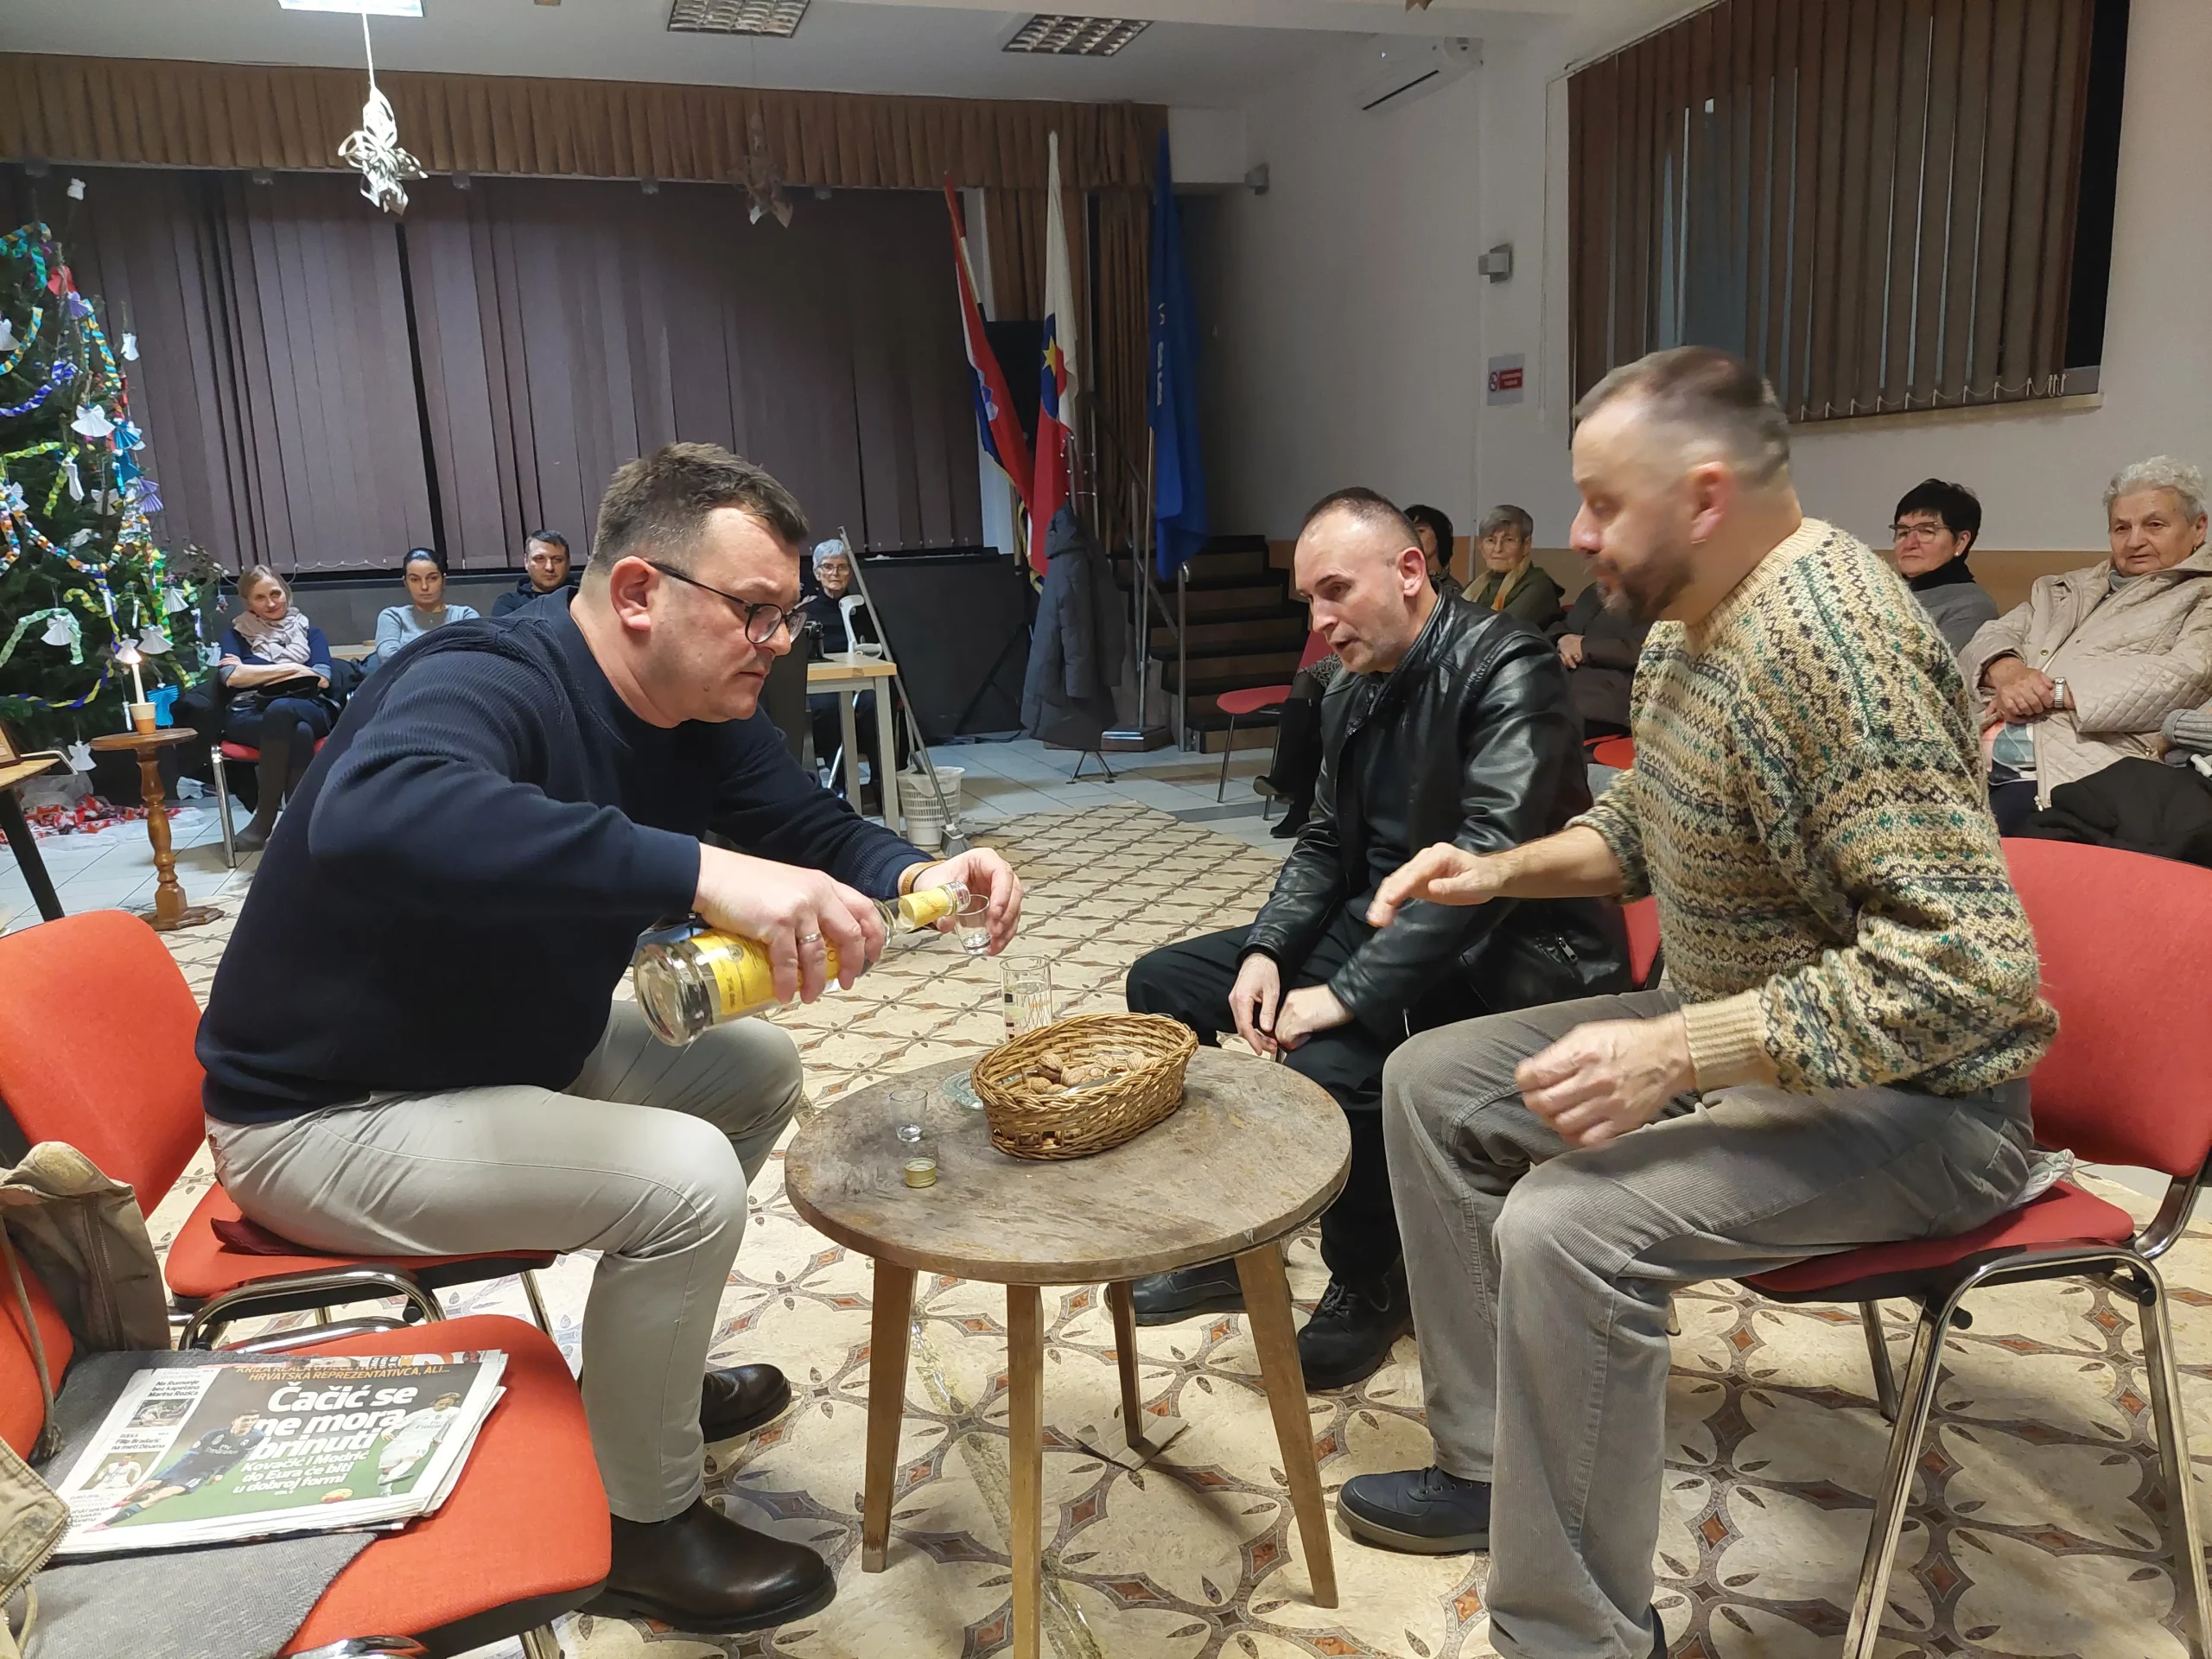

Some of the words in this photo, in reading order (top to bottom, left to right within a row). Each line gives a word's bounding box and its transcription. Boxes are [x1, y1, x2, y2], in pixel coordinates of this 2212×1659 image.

[248, 1370, 311, 1381] HRVATSKA
[312, 1366, 422, 1380] REPREZENTATIVCA,
[267, 1382, 372, 1413] Čačić
[370, 1386, 419, 1407] se
[253, 1417, 302, 1437] ne
[302, 1408, 406, 1434] mora
[246, 1427, 383, 1461] brinuti
[240, 1458, 306, 1472] Kovačić
[311, 1450, 371, 1465] Modrić
[242, 1471, 264, 1483] do
[264, 1468, 303, 1480] Eura
[304, 1465, 324, 1476] će
[325, 1461, 355, 1474] biti
[232, 1484, 245, 1494] u
[246, 1478, 302, 1492] dobroj
[301, 1473, 347, 1487] formi
